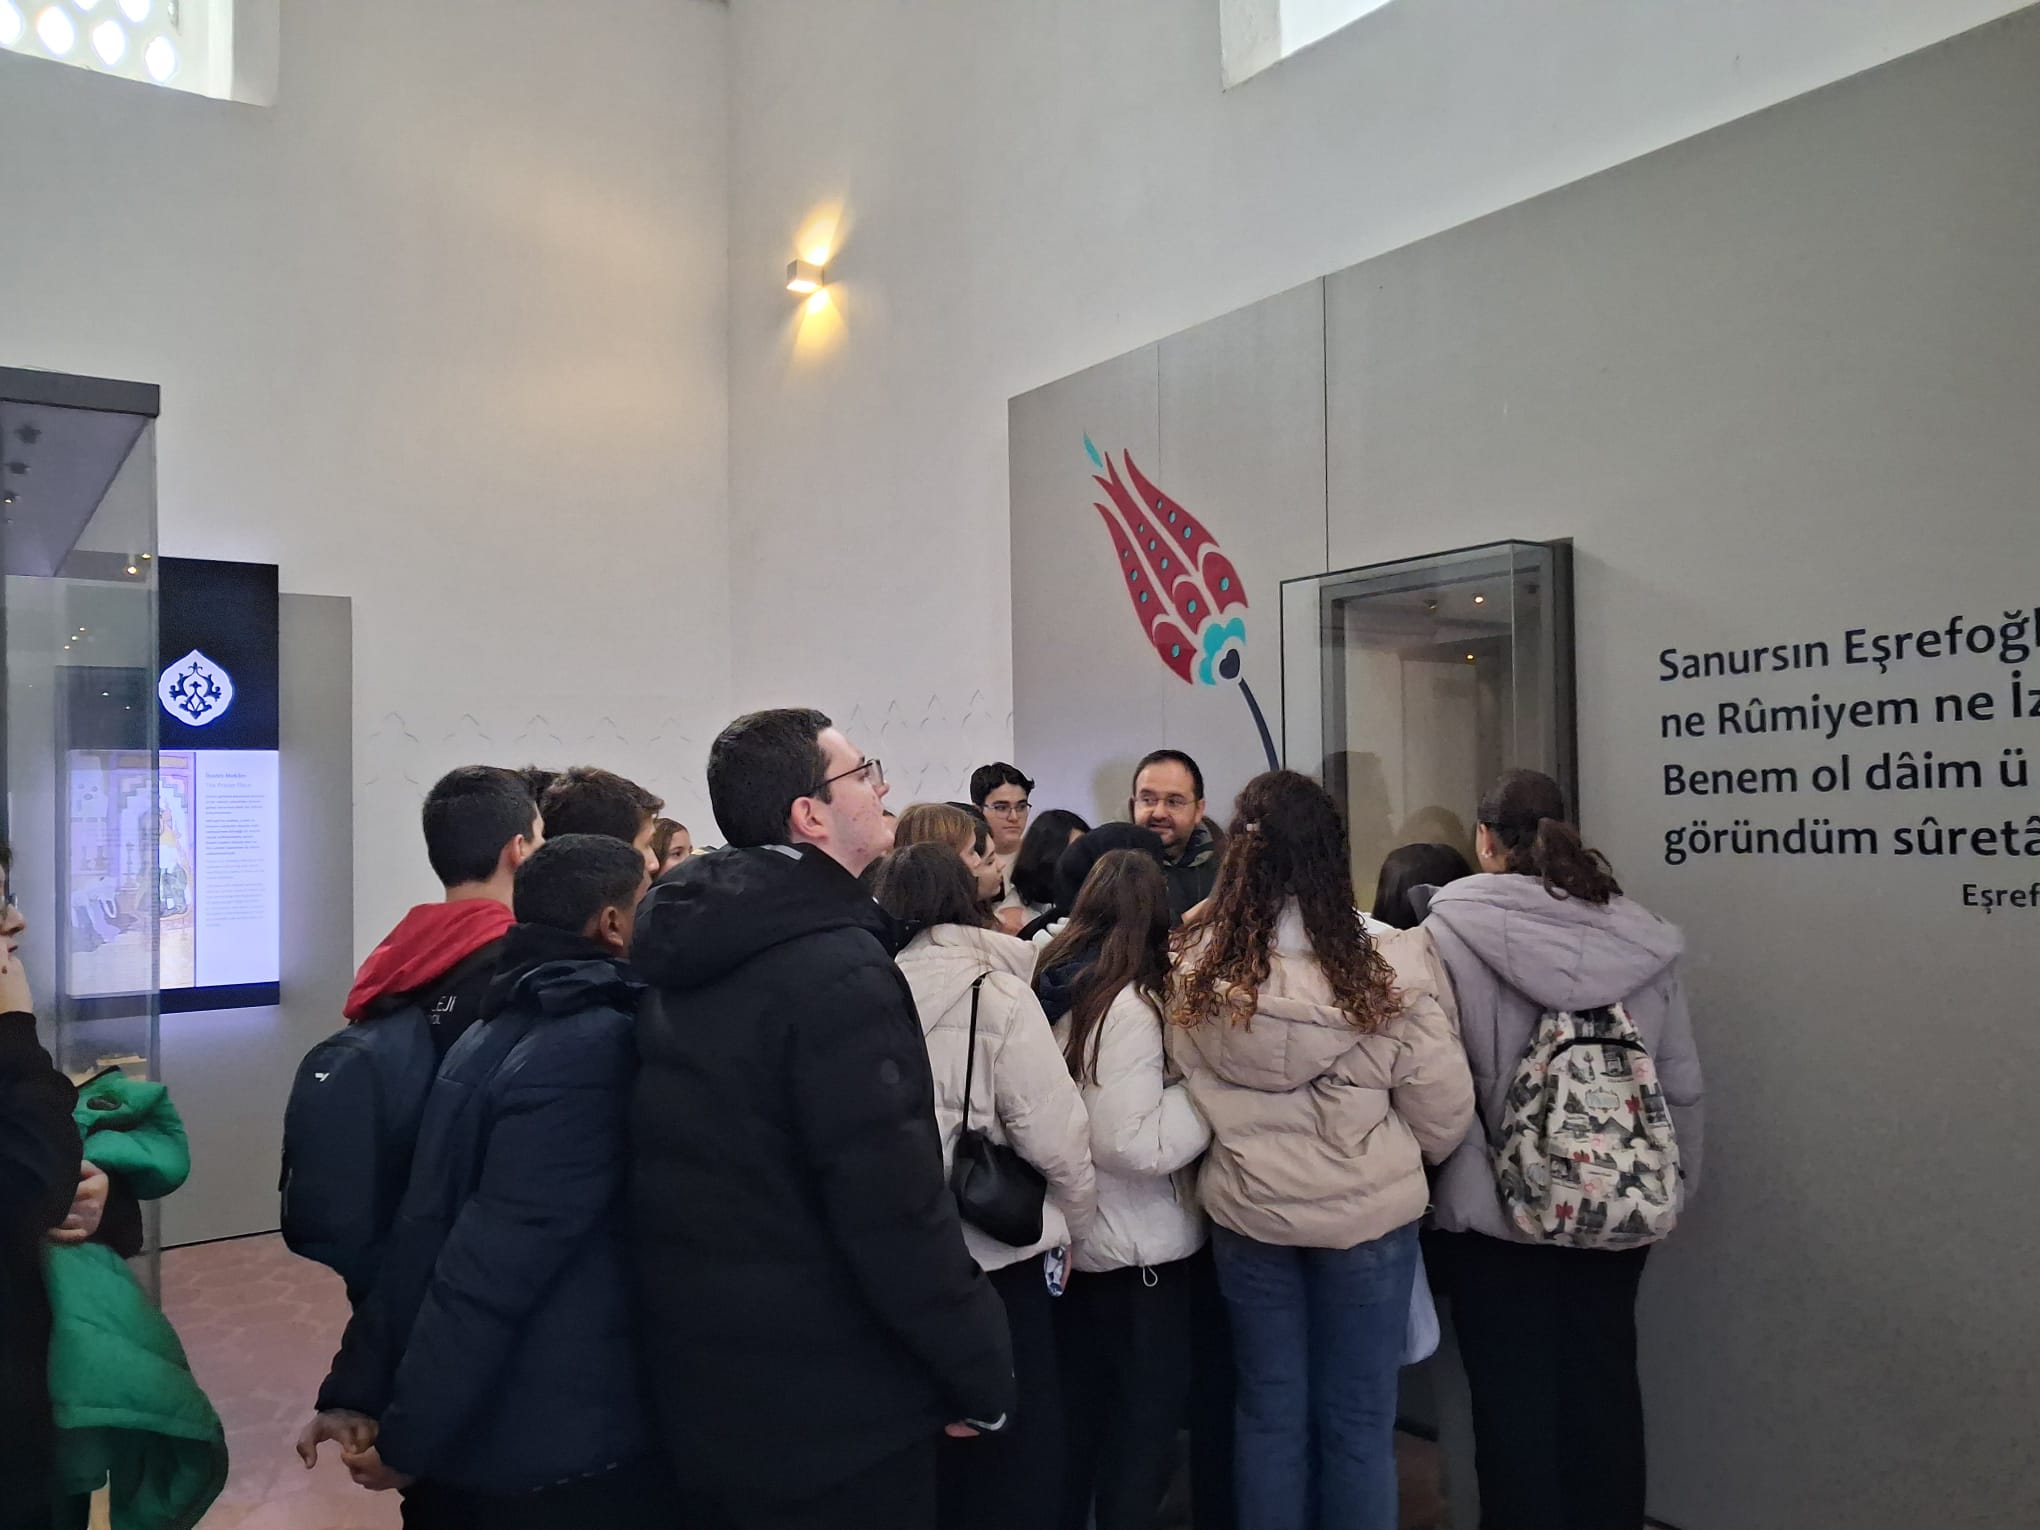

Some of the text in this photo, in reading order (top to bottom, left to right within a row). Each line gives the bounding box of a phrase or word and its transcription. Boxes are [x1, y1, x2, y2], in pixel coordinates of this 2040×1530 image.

[1659, 641, 1829, 682] Sanursın
[1661, 712, 1706, 738] ne
[1718, 693, 1919, 740] Rûmiyem
[1935, 692, 1995, 723] ne
[1663, 747, 2029, 796] Benem ol dâim ü
[1664, 818, 1878, 866] göründüm
[1962, 882, 2040, 914] Eşref
